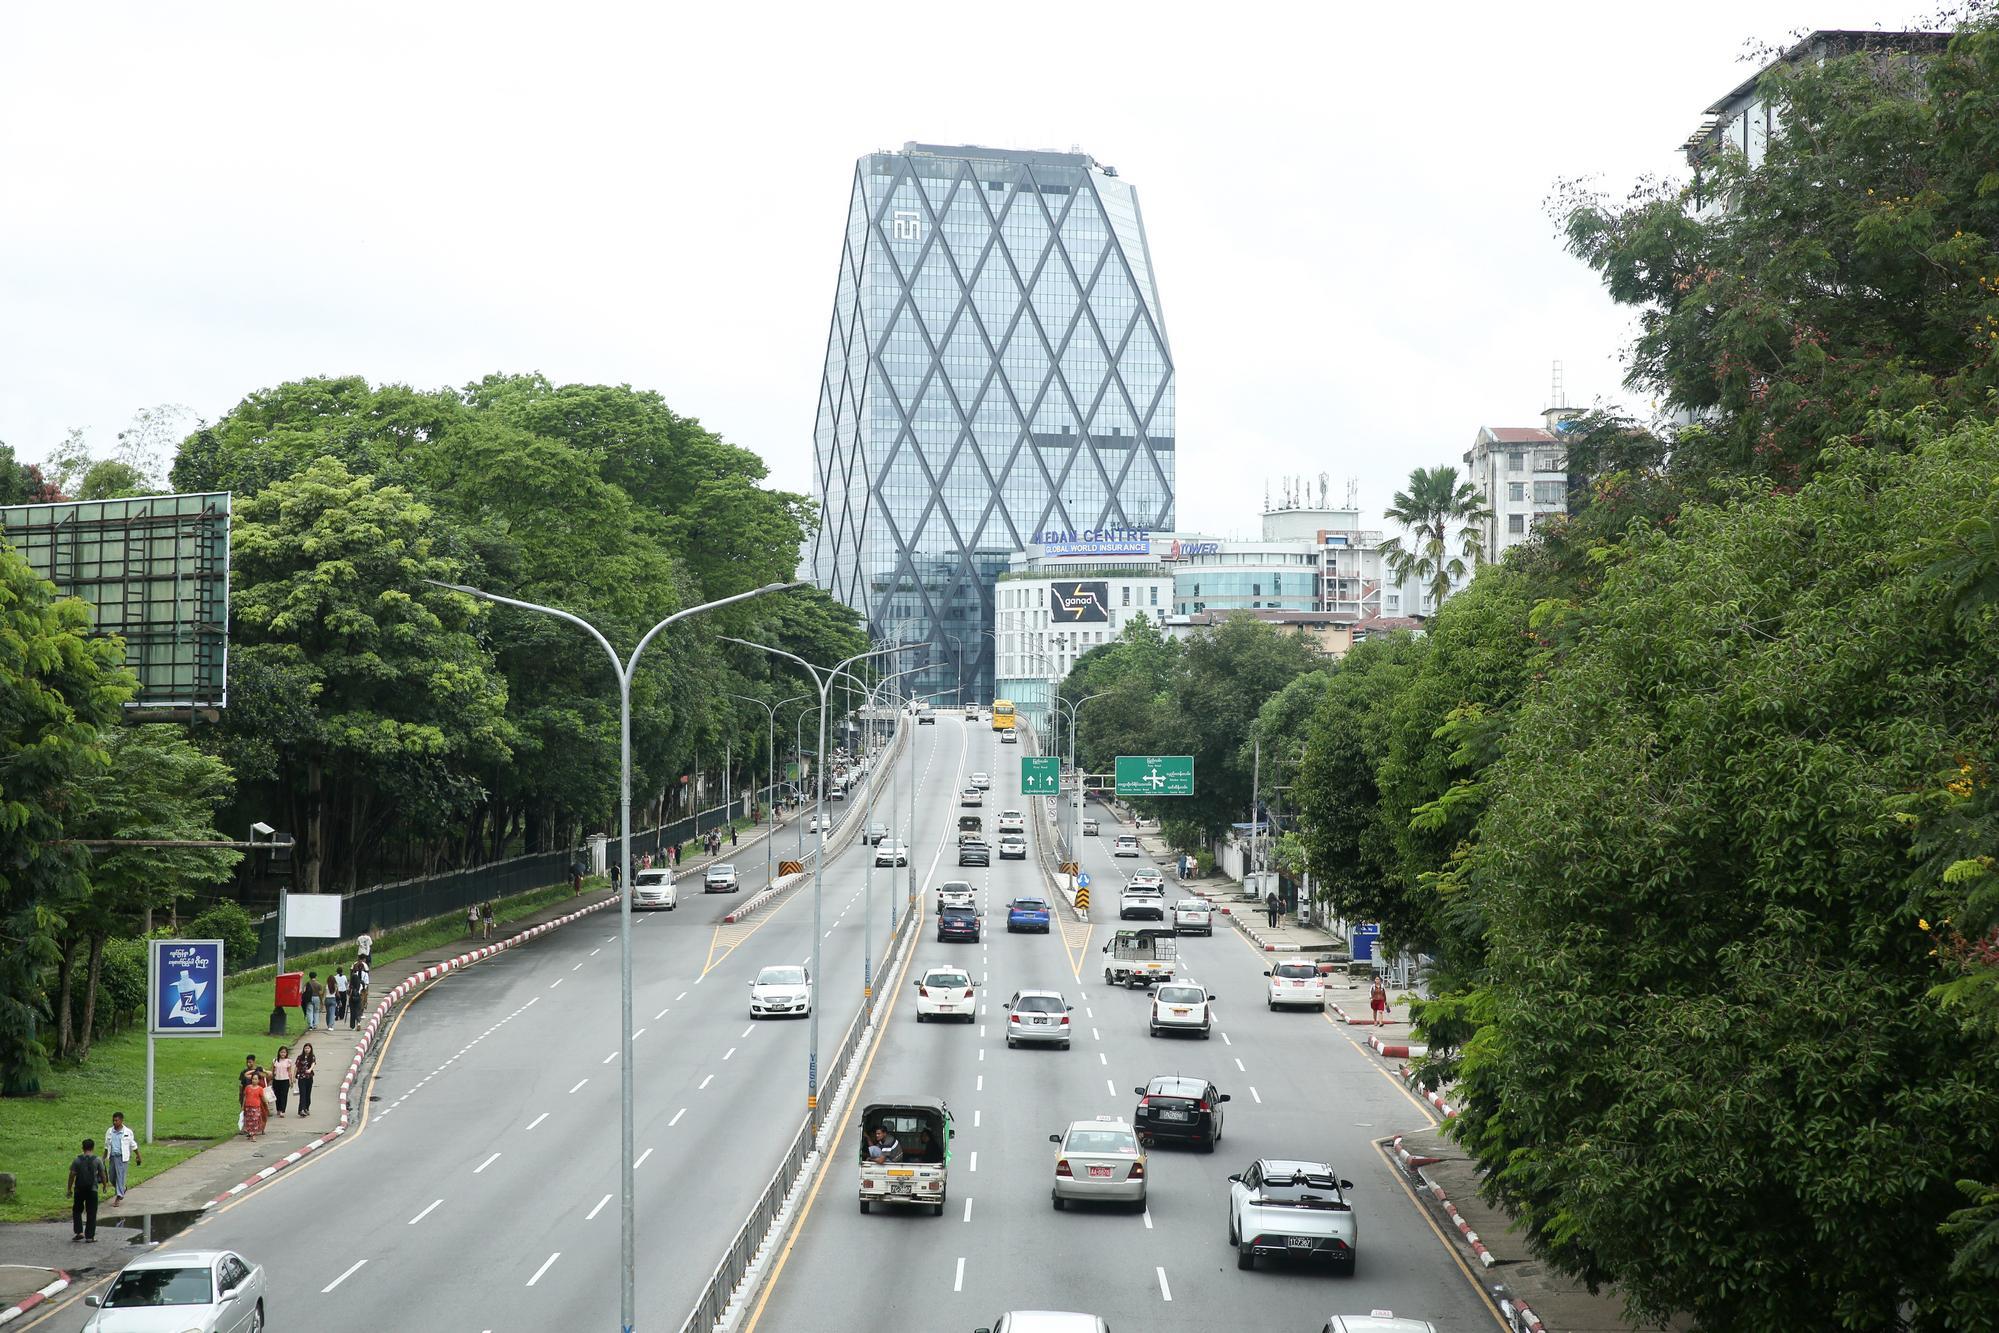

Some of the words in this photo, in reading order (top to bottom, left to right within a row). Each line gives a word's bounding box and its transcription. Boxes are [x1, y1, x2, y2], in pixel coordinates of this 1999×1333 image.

[1083, 528, 1149, 542] CENTRE
[1046, 545, 1069, 553] GLOBAL
[1071, 544, 1098, 552] WORLD
[1100, 543, 1147, 552] INSURANCE
[1181, 543, 1218, 556] TOWER
[1065, 596, 1092, 607] ganad
